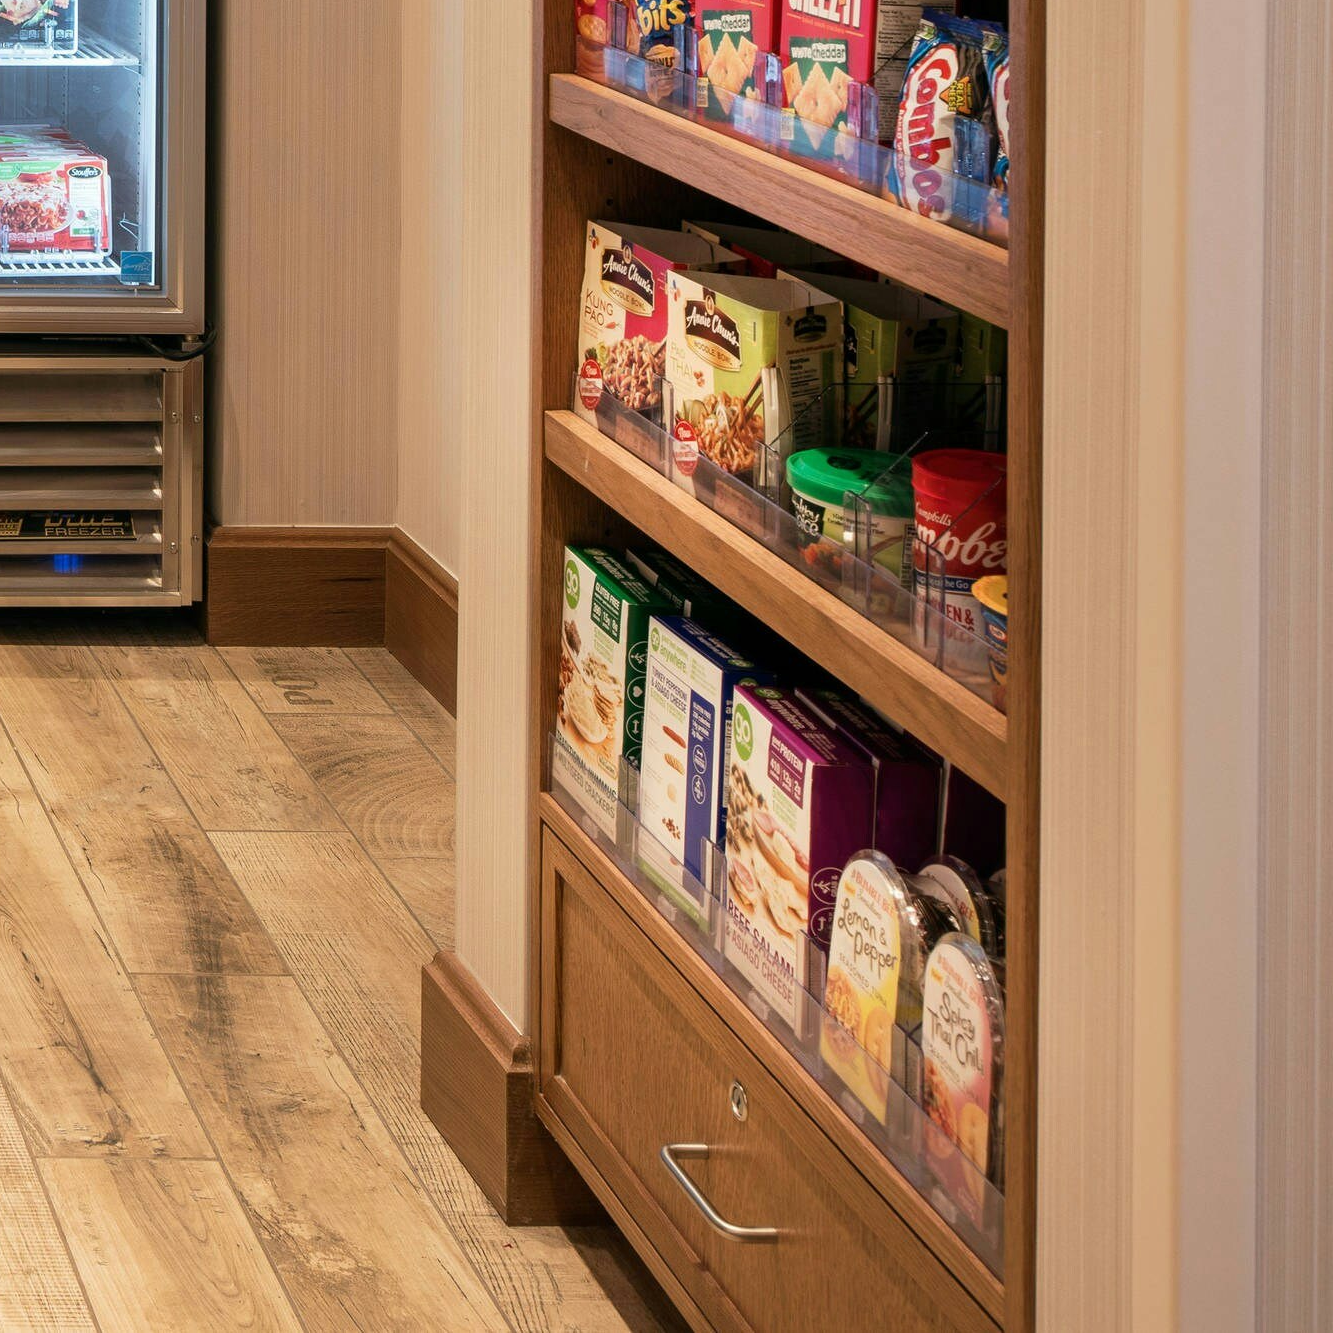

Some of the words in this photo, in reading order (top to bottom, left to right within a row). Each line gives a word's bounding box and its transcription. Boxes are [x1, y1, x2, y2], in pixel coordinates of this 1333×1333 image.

[721, 14, 750, 31] cheddar
[812, 43, 846, 61] cheddar
[947, 80, 957, 112] CHEESE
[956, 81, 965, 108] REAL
[908, 58, 952, 218] Combos
[71, 168, 99, 178] Stouffer's
[603, 254, 628, 277] Annie
[627, 265, 654, 295] Chun's
[584, 305, 605, 326] PAO
[586, 288, 614, 316] KUNG
[686, 306, 712, 329] Annie
[711, 317, 740, 346] Chun's
[45, 527, 125, 537] FREEZER
[595, 581, 609, 601] GLUTEN
[609, 593, 620, 609] FREE
[956, 579, 968, 589] Go
[735, 711, 751, 744] go
[780, 743, 804, 773] PROTEIN
[838, 897, 877, 942] Lemon
[727, 898, 750, 934] BEEF
[751, 926, 795, 986] SALAMI
[853, 932, 898, 980] Pepper
[732, 928, 761, 970] ASIAGO
[761, 961, 793, 1007] CHEESE
[941, 992, 976, 1042] Spicy
